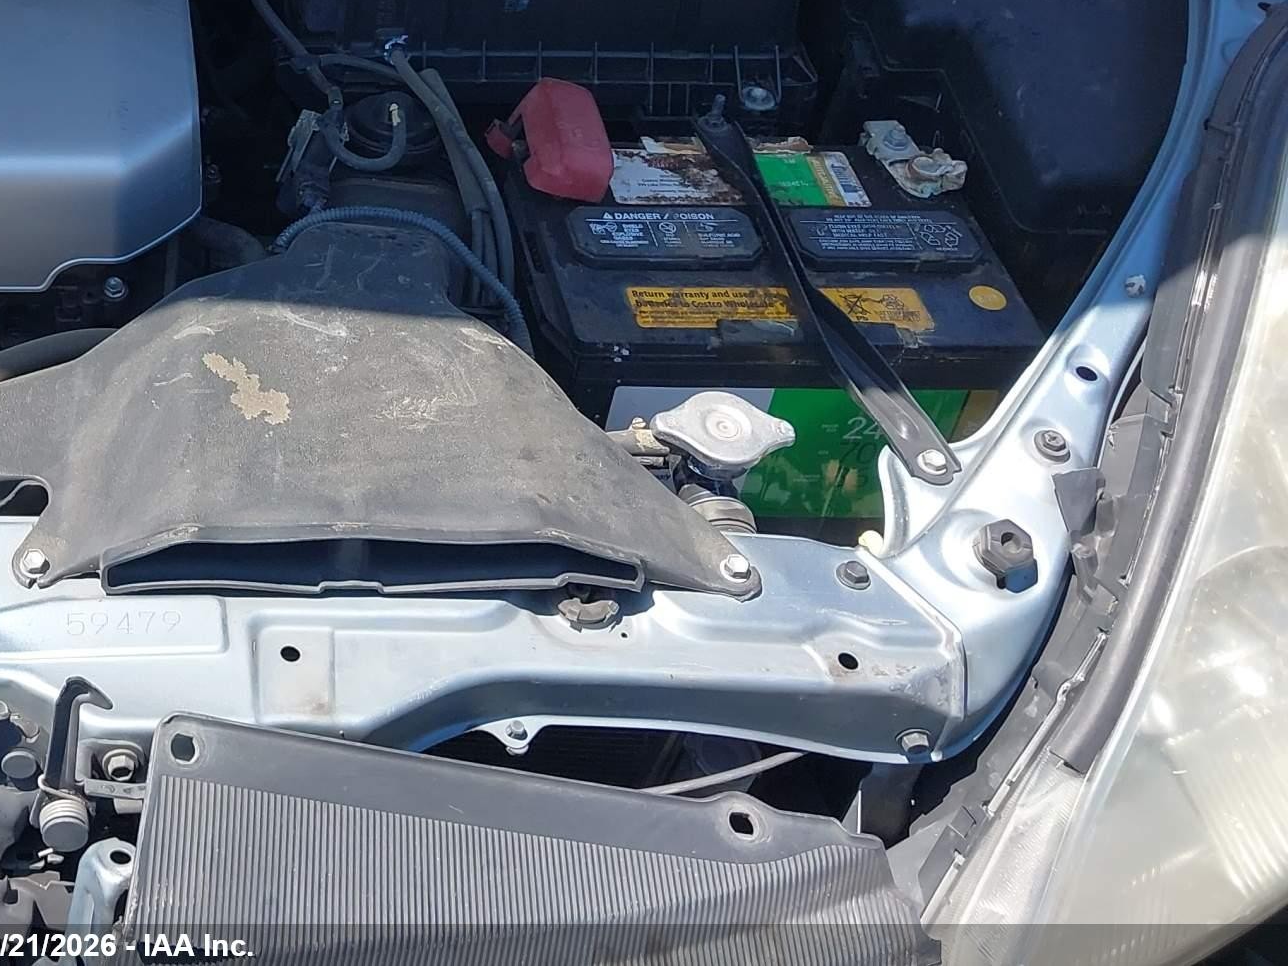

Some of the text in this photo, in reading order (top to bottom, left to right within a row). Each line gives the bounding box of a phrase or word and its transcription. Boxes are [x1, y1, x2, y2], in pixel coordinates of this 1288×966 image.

[614, 212, 660, 220] DANGER
[632, 290, 665, 298] Return
[711, 290, 730, 298] and
[691, 300, 722, 308] Costco
[67, 611, 182, 636] 59479
